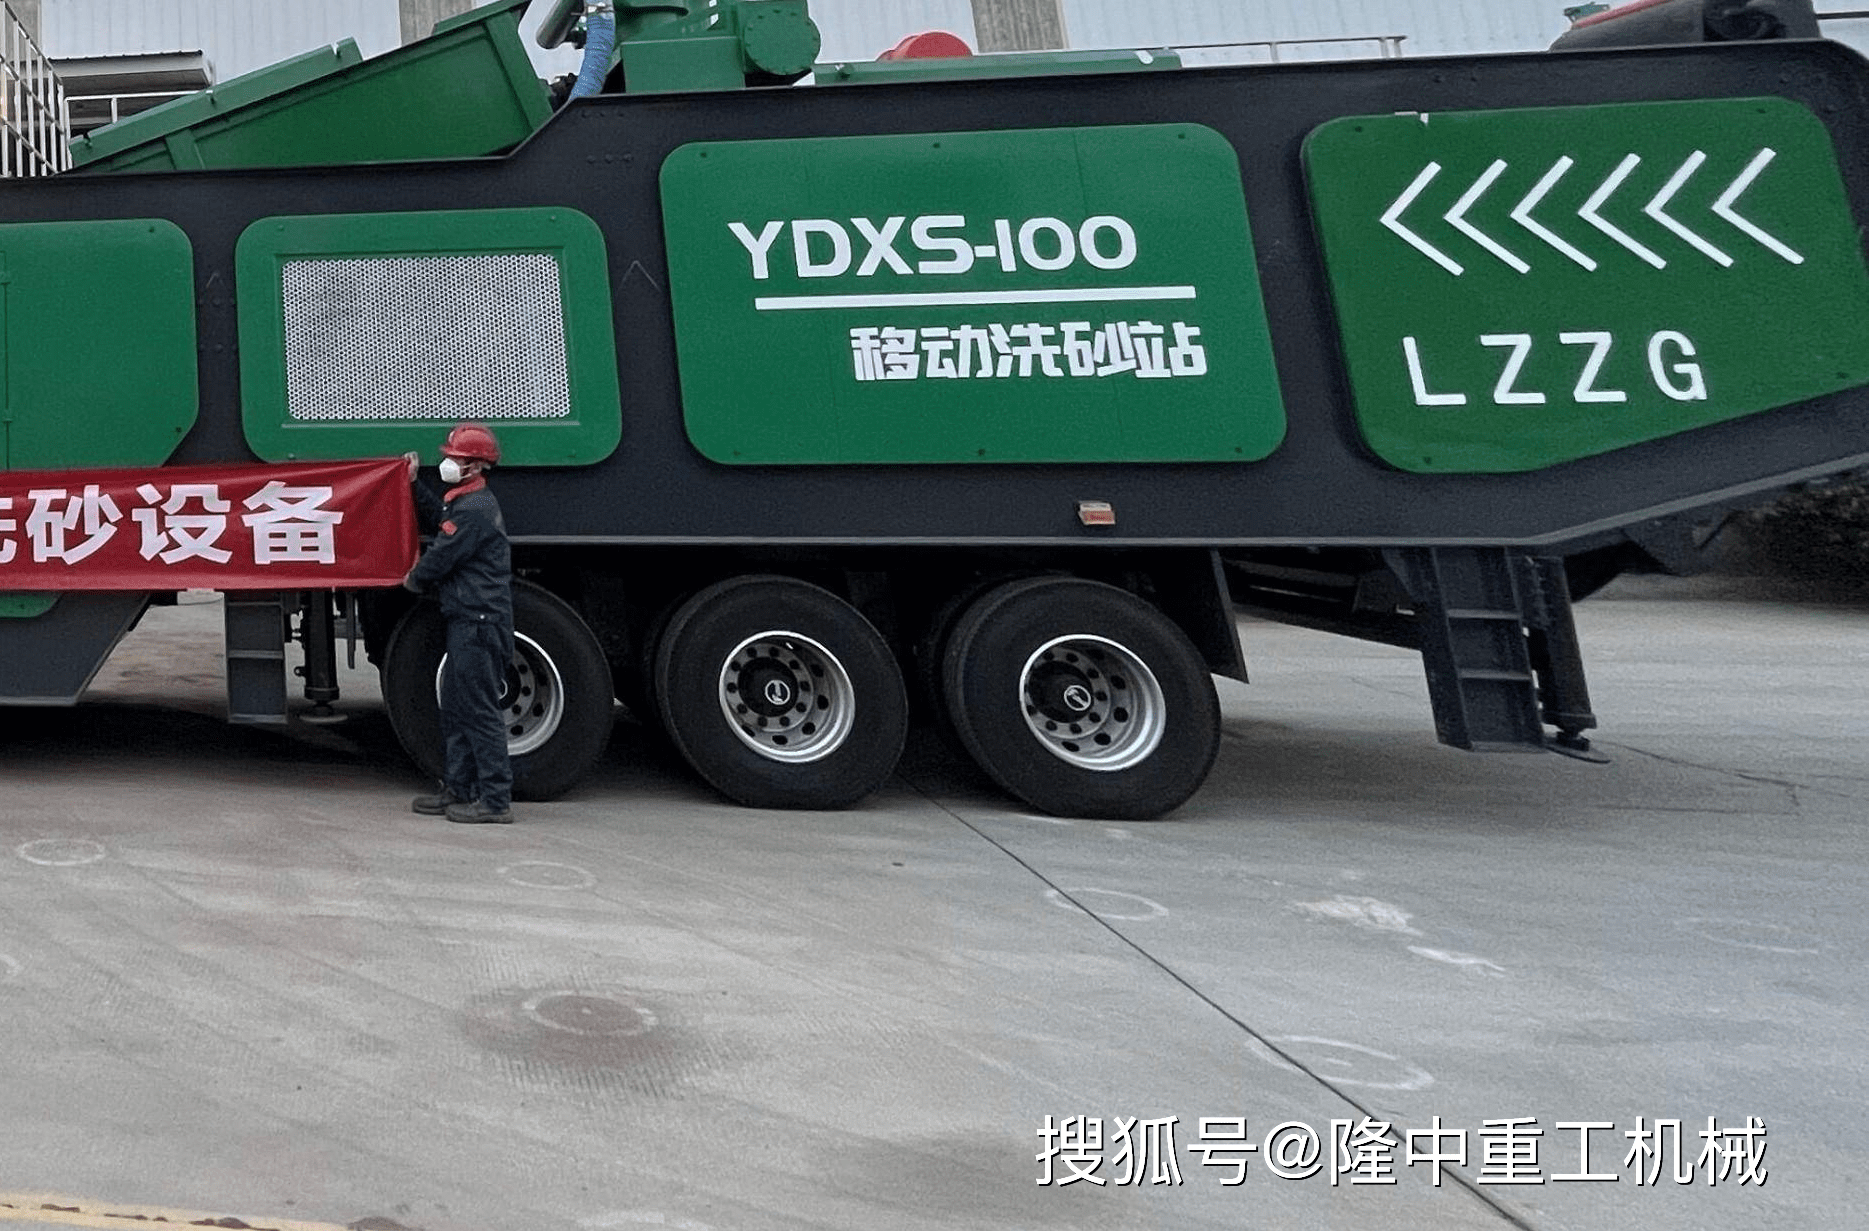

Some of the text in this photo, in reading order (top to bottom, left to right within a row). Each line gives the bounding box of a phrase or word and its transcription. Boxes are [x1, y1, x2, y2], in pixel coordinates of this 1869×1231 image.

[728, 214, 1138, 280] YDXS-100
[849, 320, 1208, 382] 移动洗砂站
[1401, 330, 1708, 406] LZZG
